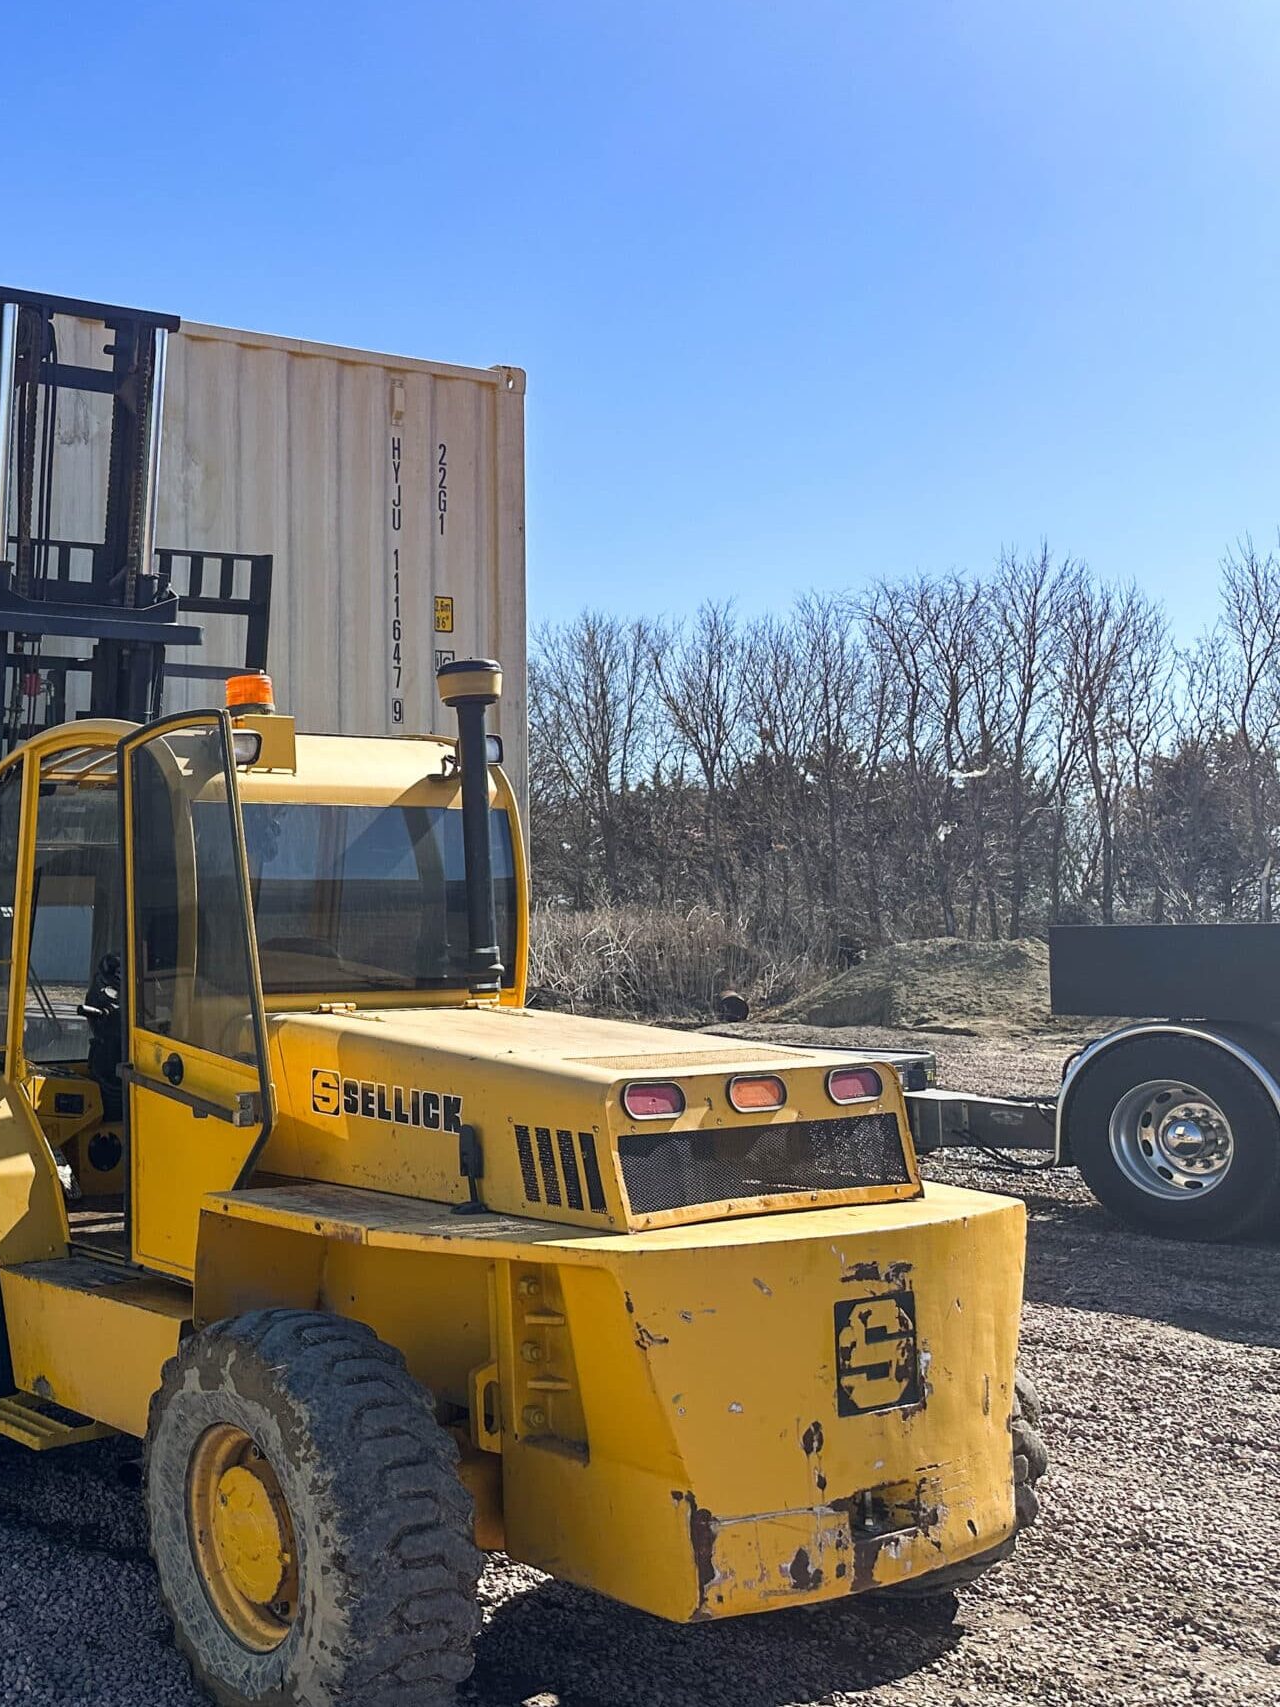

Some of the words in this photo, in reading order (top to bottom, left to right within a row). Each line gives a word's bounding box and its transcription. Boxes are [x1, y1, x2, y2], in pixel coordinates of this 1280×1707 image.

[392, 437, 401, 531] HYJU
[439, 443, 447, 535] 22G1
[392, 548, 402, 689] 111647
[393, 700, 402, 723] 9
[343, 1078, 462, 1134] SELLICK
